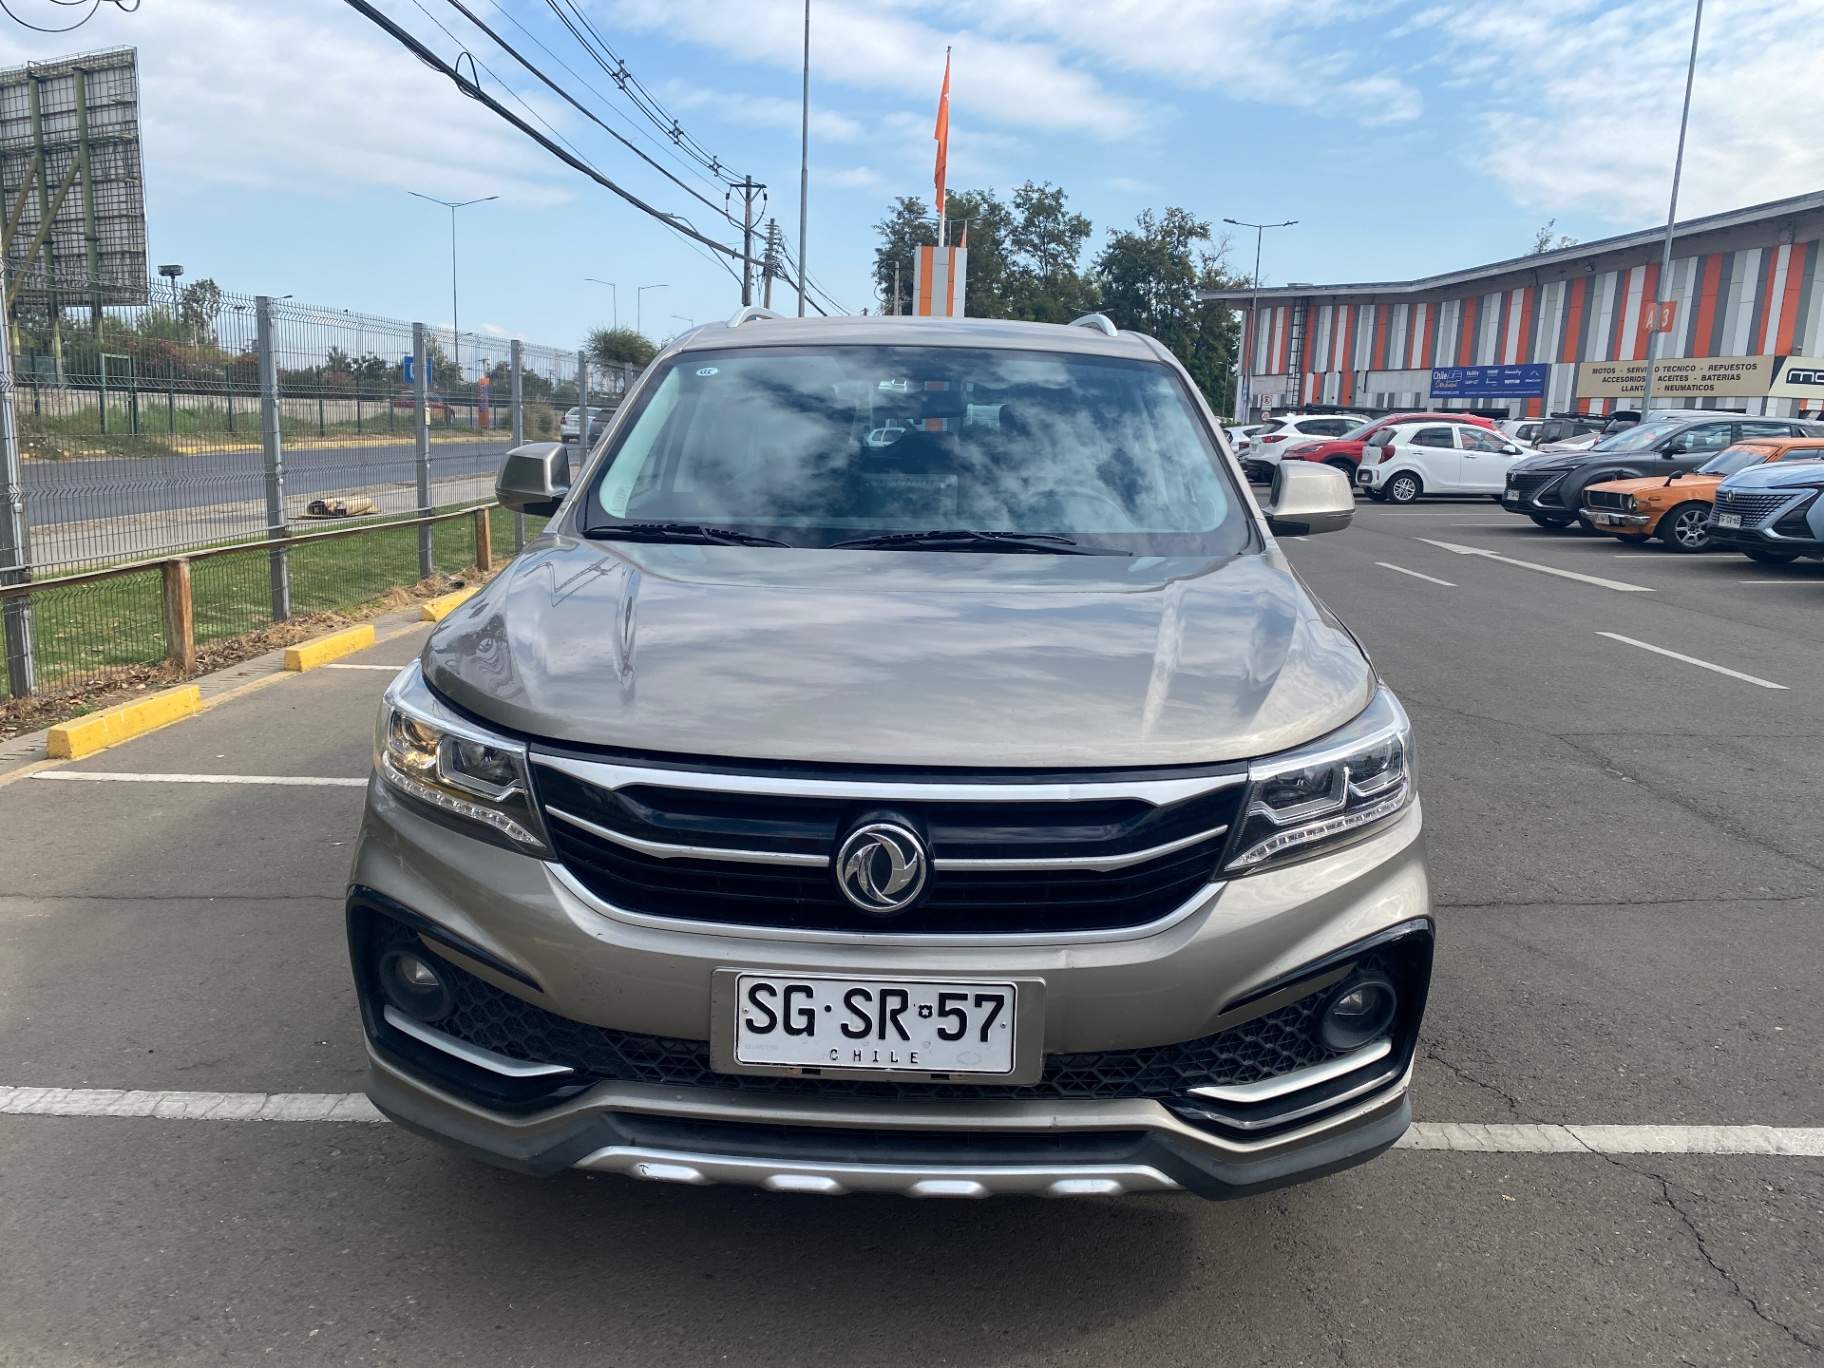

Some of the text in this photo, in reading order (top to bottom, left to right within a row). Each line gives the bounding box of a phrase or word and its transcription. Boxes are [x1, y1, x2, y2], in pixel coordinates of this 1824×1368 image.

[1592, 363, 1758, 375] MOTOS SERVIO TECNICO REPUESTOS
[1602, 374, 1742, 383] ACCESORIOS ACEITES BATERIAS
[1621, 384, 1715, 393] LLANT NEUMATICOS
[829, 1048, 919, 1064] CHILE
